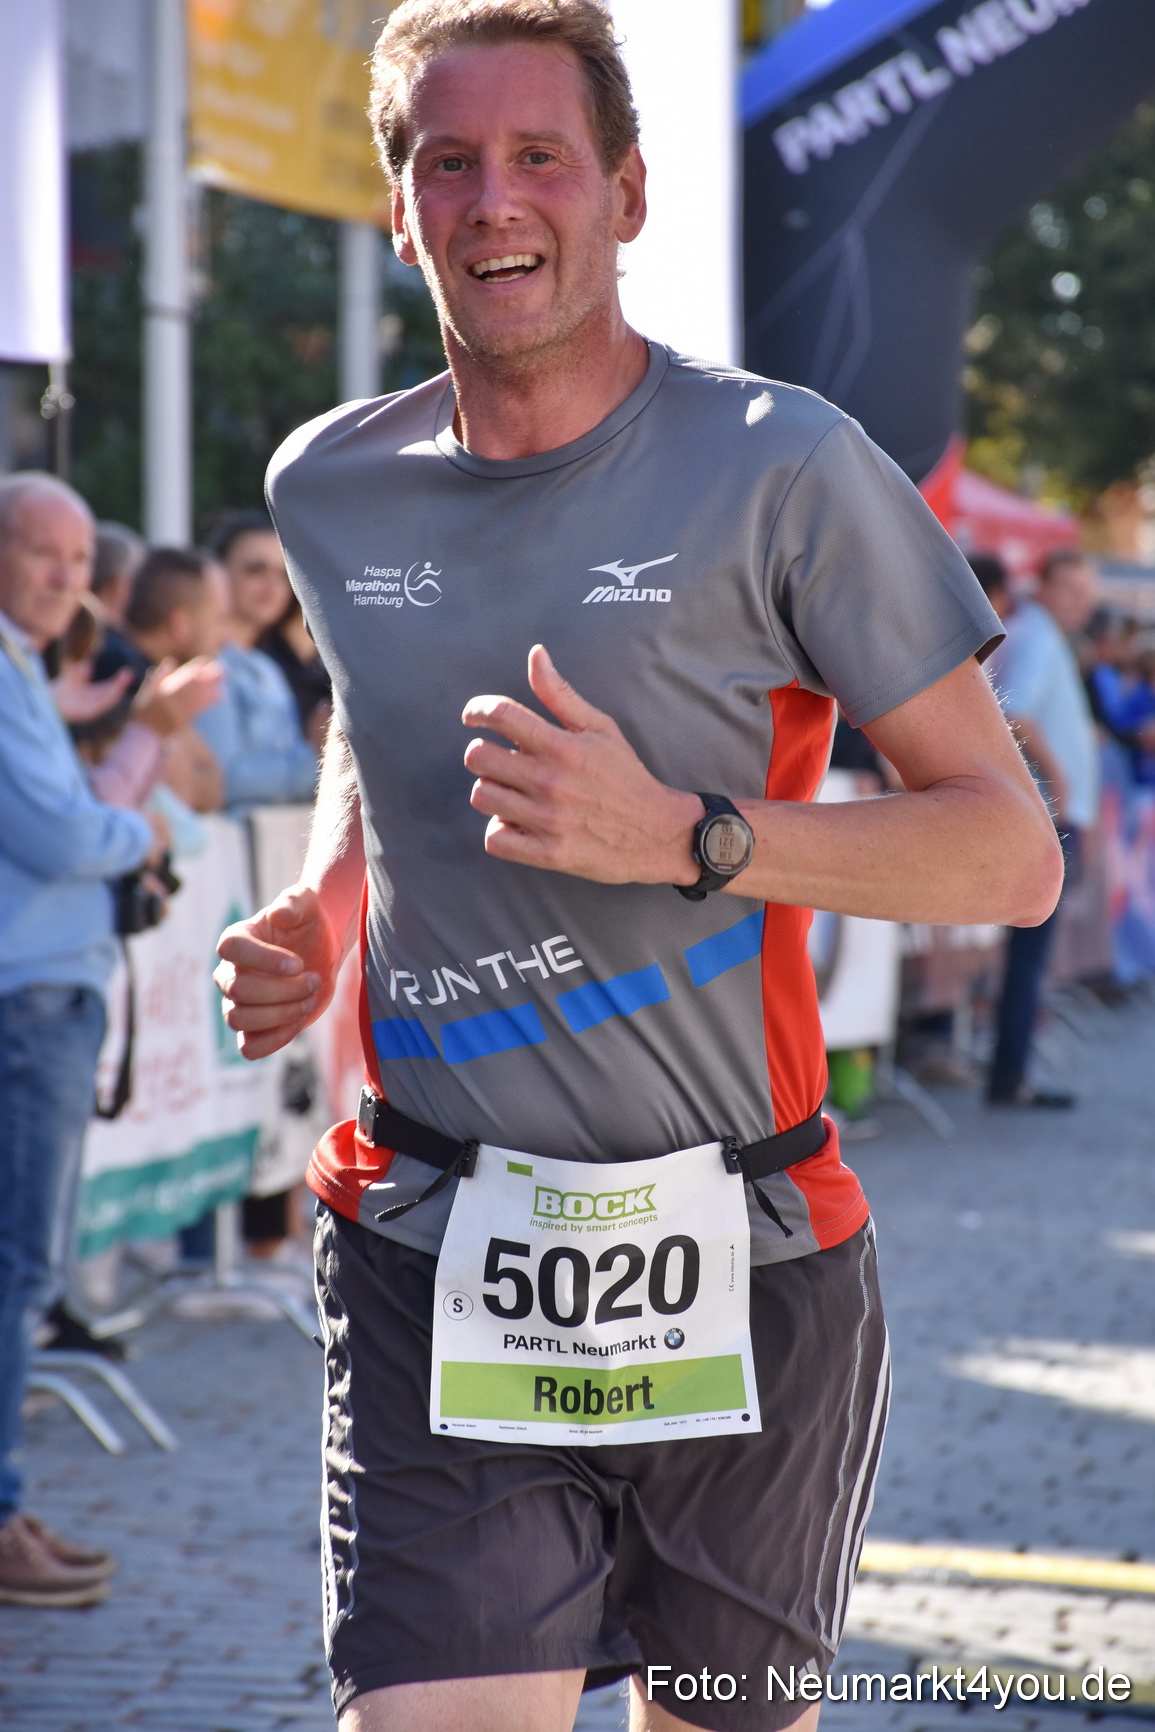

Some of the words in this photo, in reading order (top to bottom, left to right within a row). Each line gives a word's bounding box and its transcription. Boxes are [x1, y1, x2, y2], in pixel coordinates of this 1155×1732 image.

[773, 50, 952, 174] PARTL
[363, 565, 402, 579] Haspa
[345, 579, 401, 592] Marathon
[353, 594, 404, 608] Hamburg
[476, 935, 584, 990] THE
[533, 1183, 657, 1221] BOCK
[529, 1216, 568, 1231] inspired
[570, 1223, 583, 1234] by
[586, 1222, 617, 1232] smart
[618, 1213, 658, 1229] concepts
[482, 1234, 700, 1328] 5020
[452, 1298, 463, 1313] S
[503, 1334, 568, 1355] PARTL
[573, 1335, 657, 1357] Neumarkt
[533, 1375, 655, 1415] Robert
